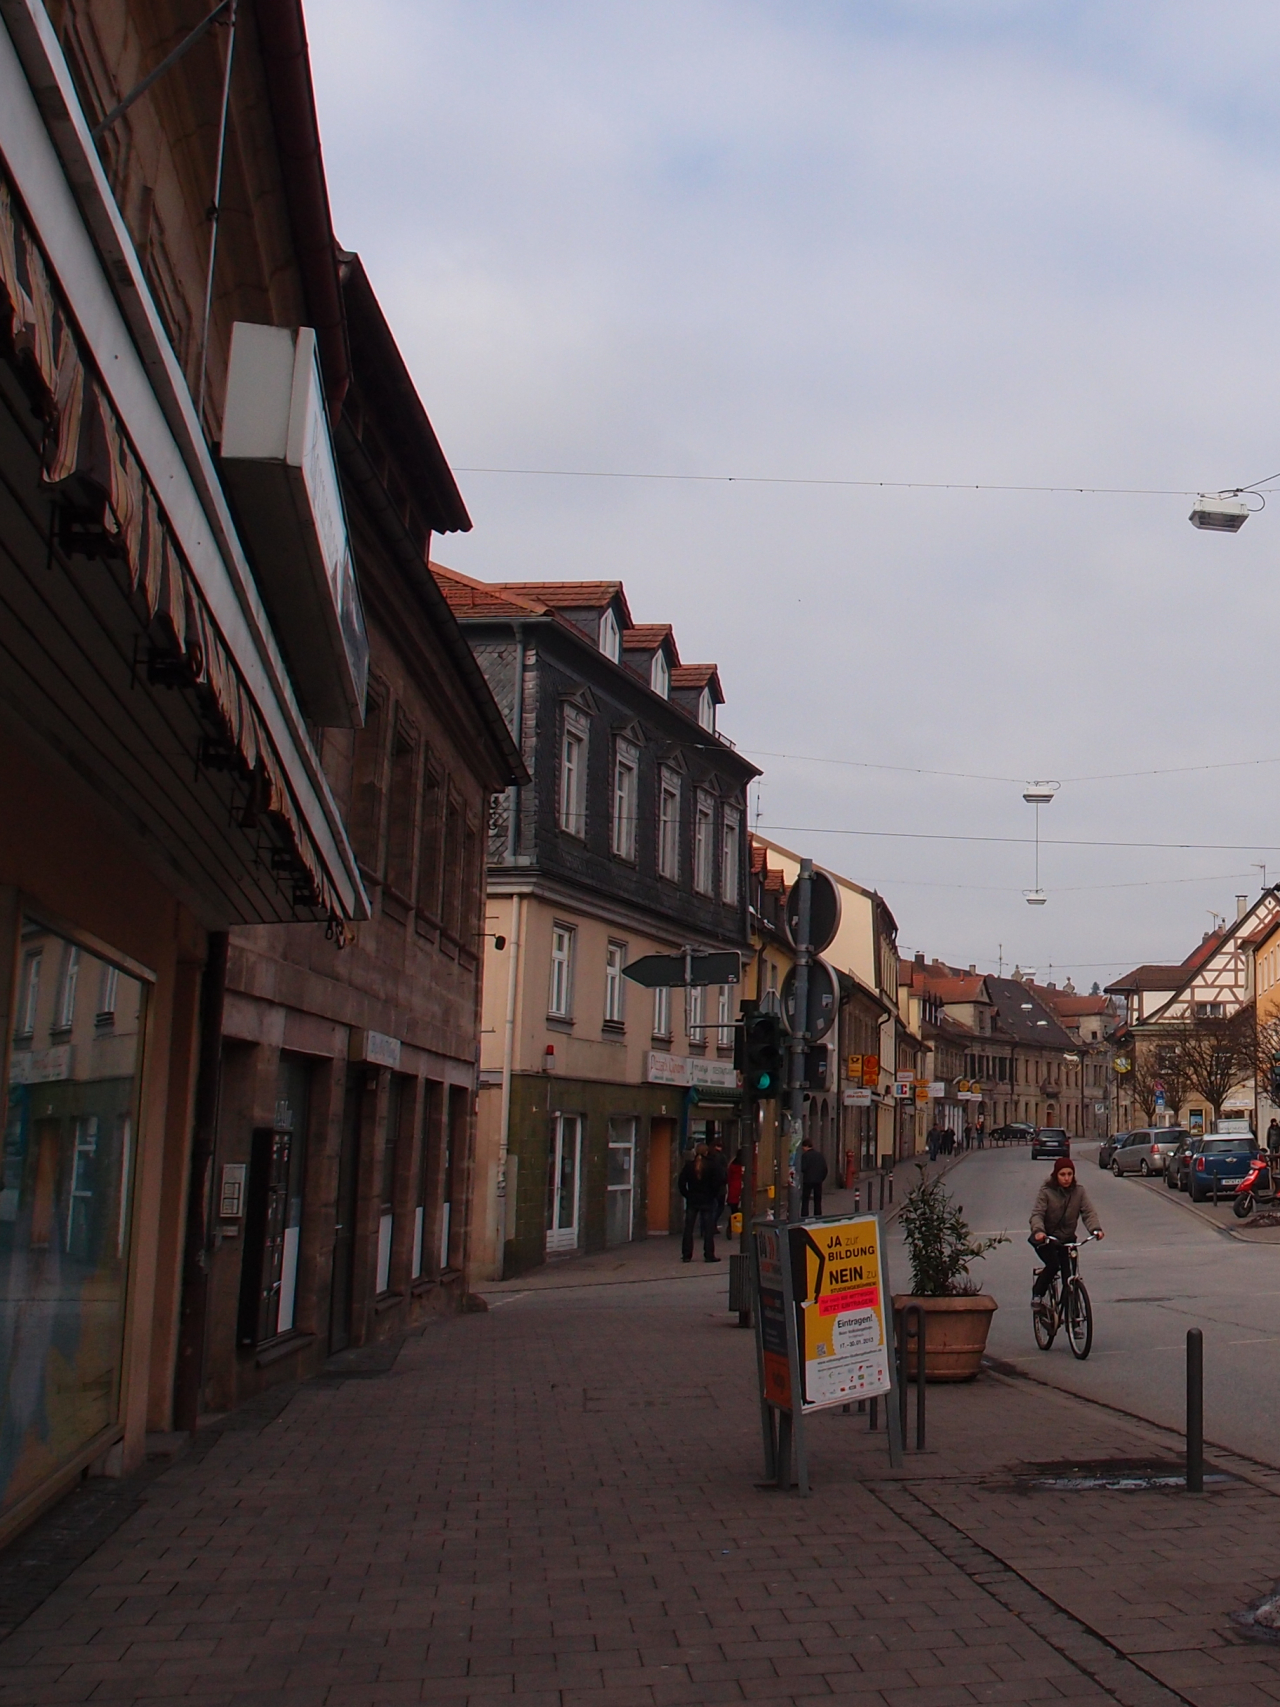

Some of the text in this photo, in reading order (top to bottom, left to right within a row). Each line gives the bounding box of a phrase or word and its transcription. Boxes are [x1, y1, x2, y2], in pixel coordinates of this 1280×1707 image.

[827, 1235, 859, 1249] JA zur
[828, 1245, 875, 1262] BILDUNG
[829, 1266, 877, 1285] NEIN zu
[837, 1313, 873, 1329] Eintragen!
